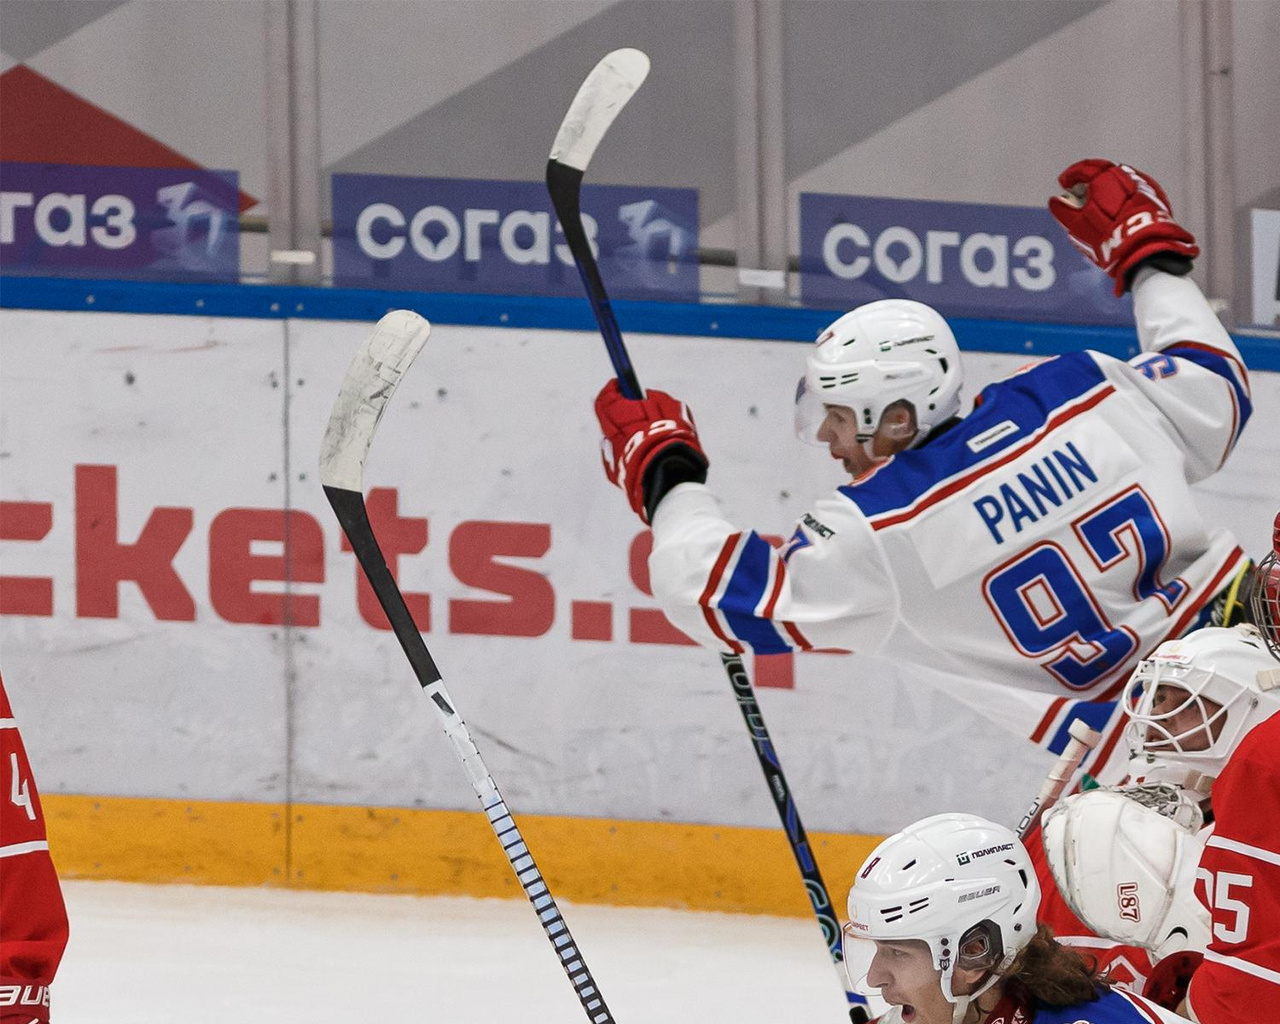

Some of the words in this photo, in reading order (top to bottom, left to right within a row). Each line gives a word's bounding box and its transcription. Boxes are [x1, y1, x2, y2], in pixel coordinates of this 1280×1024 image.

[973, 441, 1098, 544] PANIN
[981, 482, 1192, 692] 97
[10, 753, 36, 820] 4
[1118, 882, 1141, 922] L87
